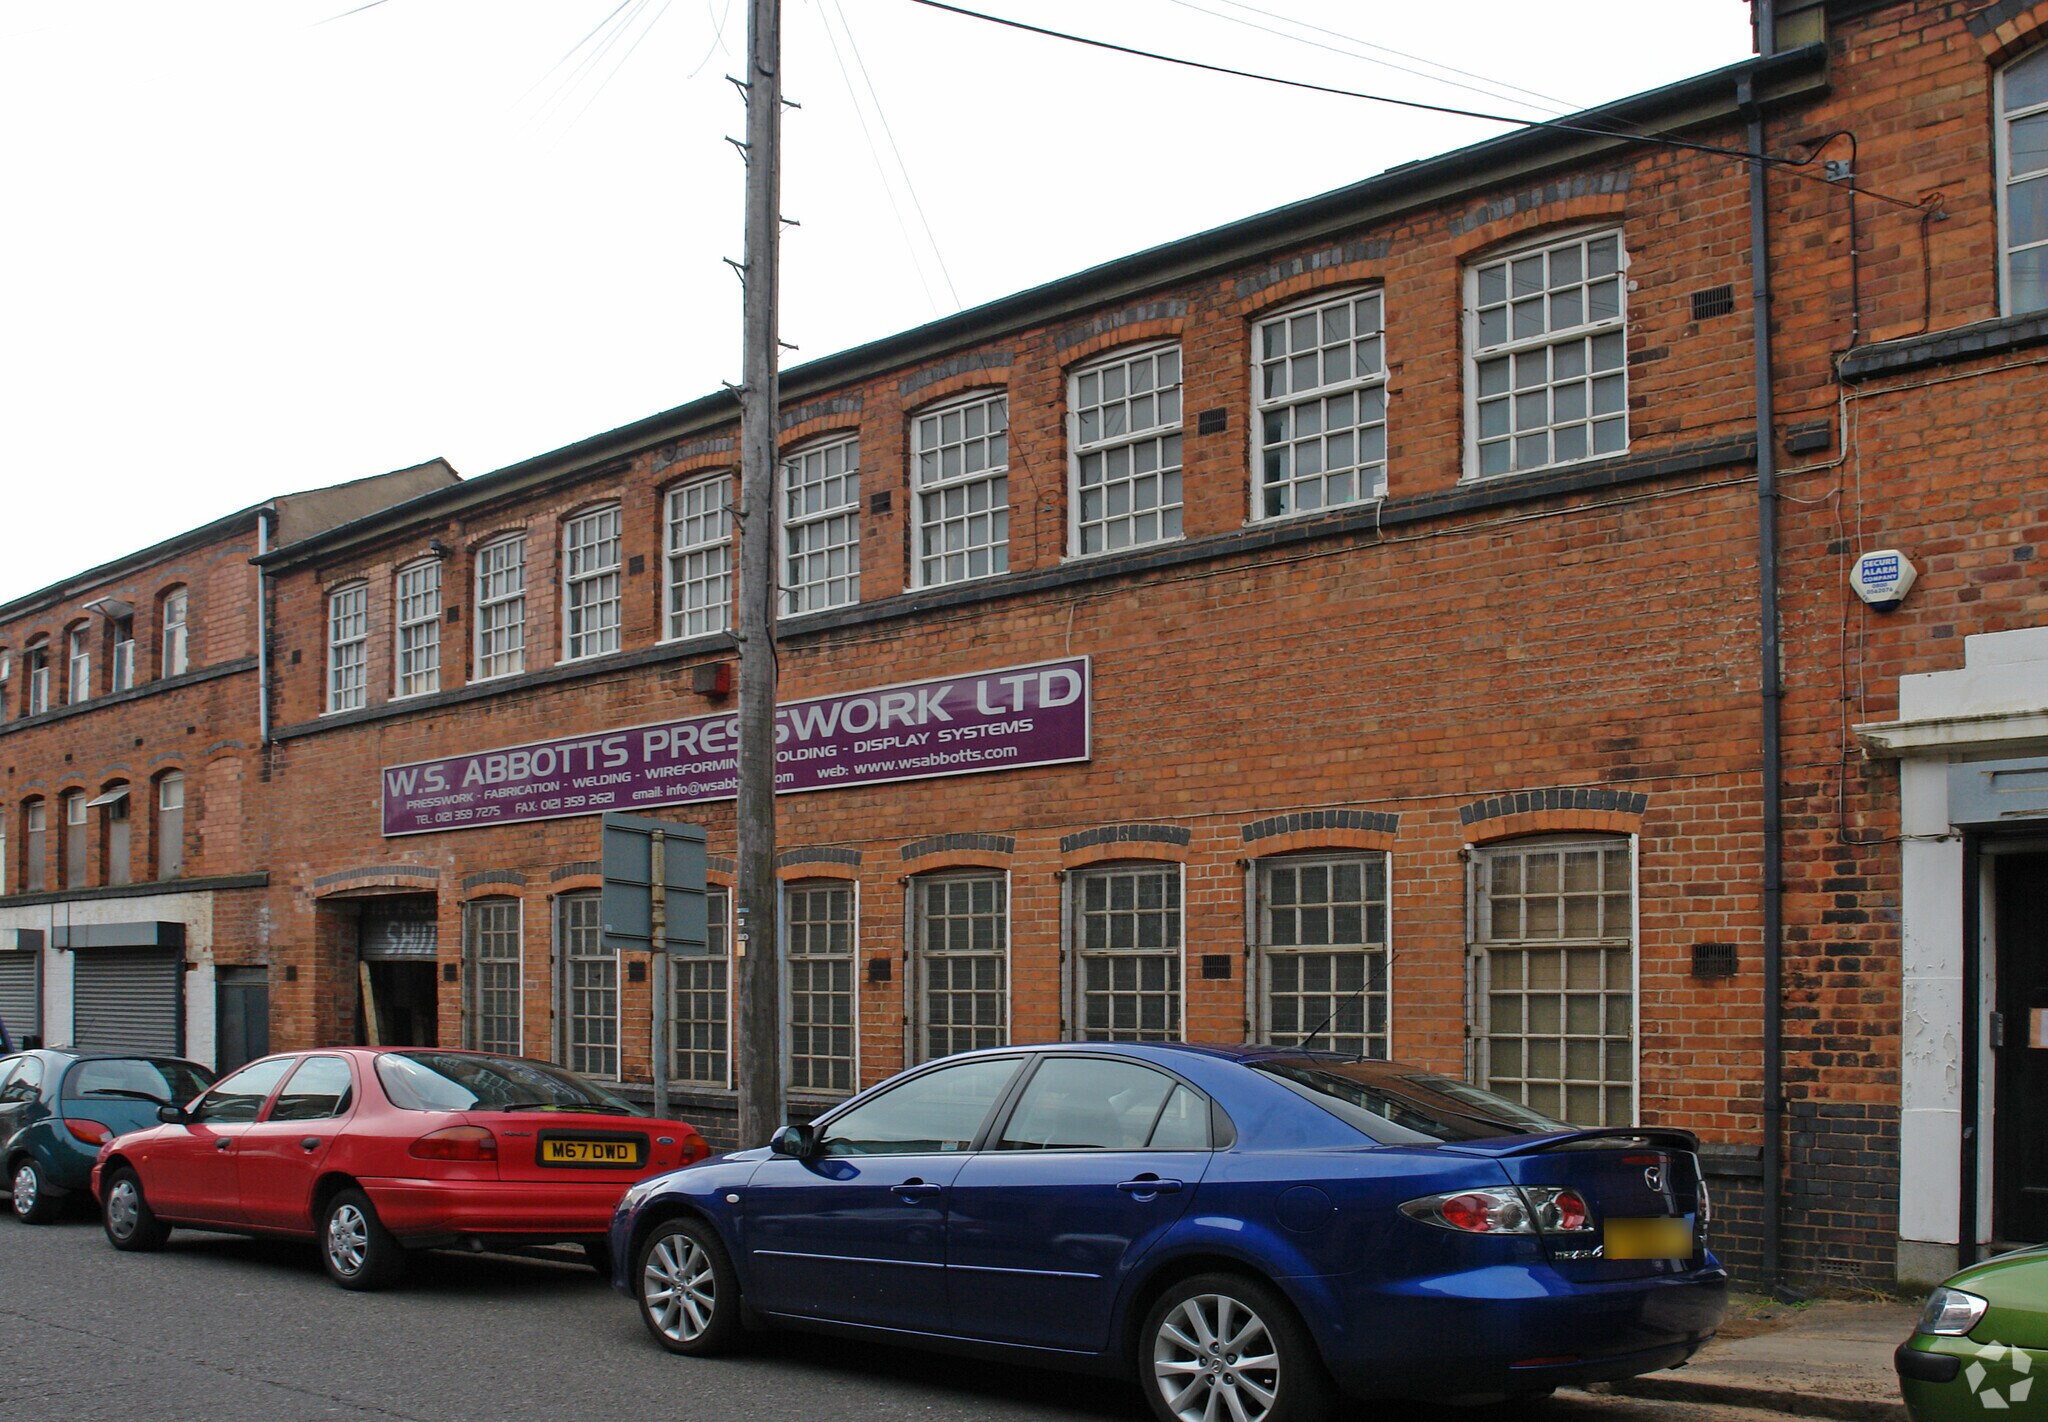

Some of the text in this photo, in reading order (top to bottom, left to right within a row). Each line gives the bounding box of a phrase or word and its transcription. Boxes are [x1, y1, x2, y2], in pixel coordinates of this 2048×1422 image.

[1863, 558, 1896, 567] SECURE
[1863, 566, 1897, 576] ALARM
[1863, 574, 1897, 582] COMPANY
[387, 764, 450, 797] W.S.
[461, 735, 629, 788] ABBOTTS
[976, 668, 1082, 716] LTD
[406, 792, 474, 810] PRESSWORK
[484, 781, 560, 800] FABRICATION
[572, 771, 632, 789] WELDING
[645, 758, 739, 780] WIREFORMIN
[776, 744, 838, 763] OLDING
[854, 731, 931, 754] DISPLAY
[937, 718, 1034, 743] SYSTEMS
[435, 811, 453, 823] 0121
[454, 808, 474, 821] 359
[475, 805, 501, 818] 7275
[540, 797, 562, 811] 0121
[563, 794, 586, 808] 359
[588, 791, 616, 805] 2621
[632, 786, 663, 800] email:
[817, 763, 849, 779] web:
[854, 746, 1018, 775] www.wsabbotts.com
[552, 1142, 629, 1160] M67 DWD
